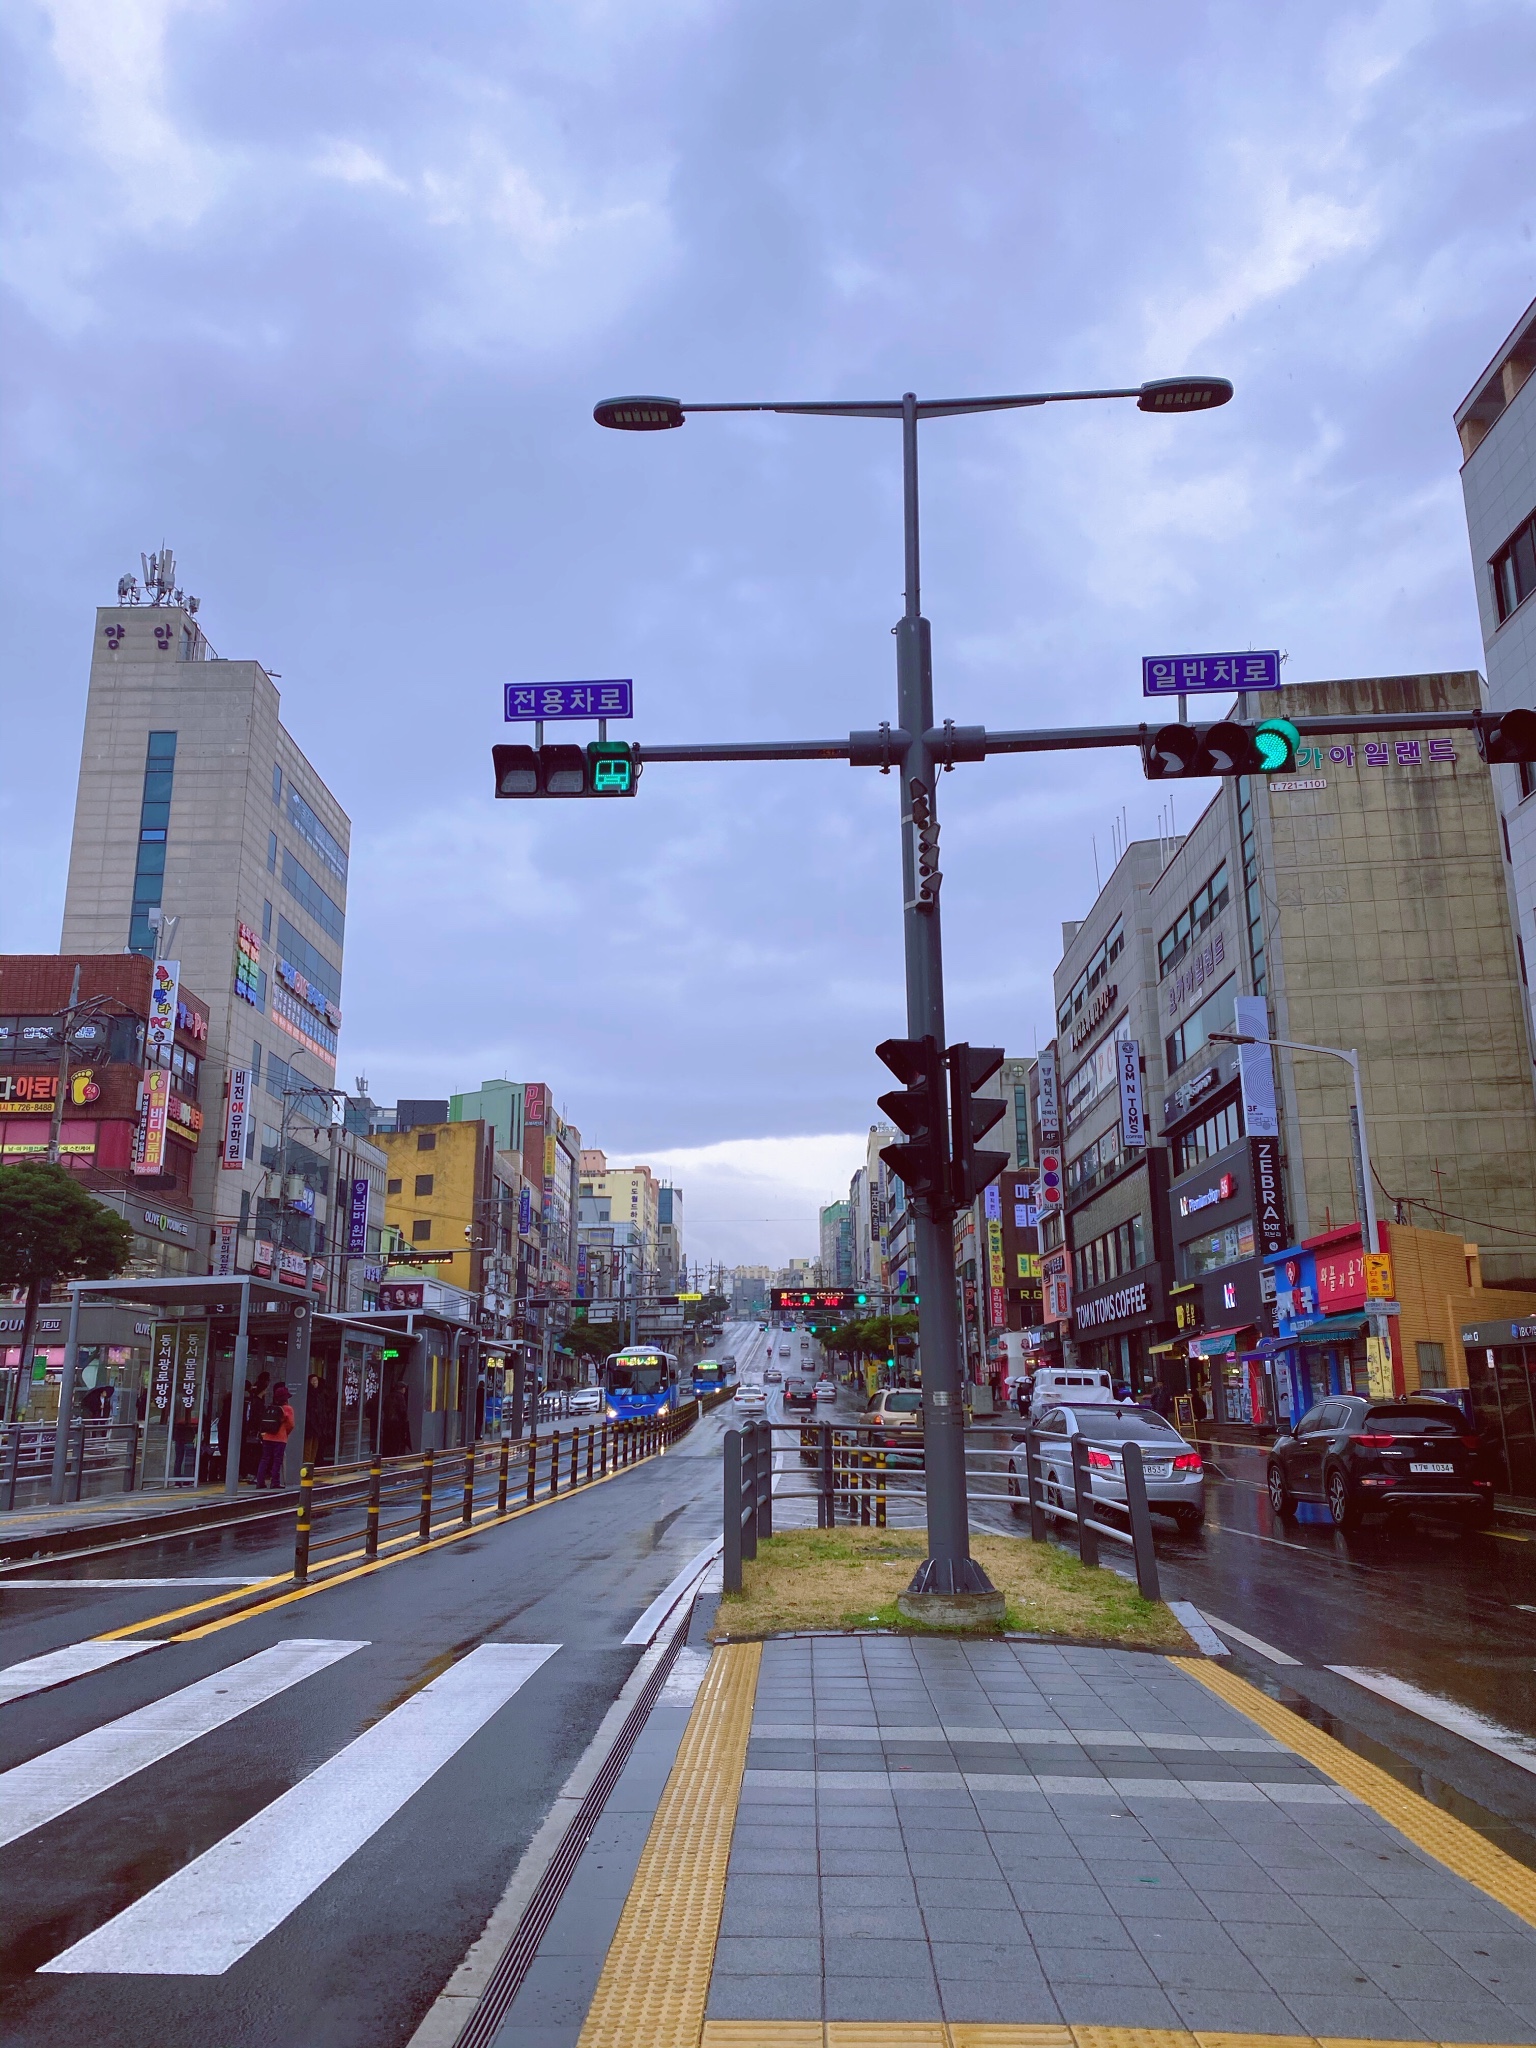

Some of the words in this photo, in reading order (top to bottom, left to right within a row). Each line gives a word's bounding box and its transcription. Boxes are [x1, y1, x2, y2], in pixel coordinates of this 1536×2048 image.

[1151, 659, 1270, 689] 일반차로
[513, 687, 623, 714] 전용차로
[1271, 780, 1326, 791] T.721-1101
[1125, 1055, 1135, 1081] TOM
[86, 1086, 96, 1094] 24
[525, 1085, 543, 1120] PC
[1127, 1085, 1135, 1094] N
[1042, 1117, 1058, 1127] PC
[1128, 1098, 1139, 1134] TOMS
[1258, 1144, 1280, 1220] ZEBRA
[352, 1195, 366, 1237] 넘버원
[1263, 1221, 1280, 1231] bar
[1095, 1294, 1116, 1323] TOMS
[1115, 1282, 1147, 1319] COFFEE
[41, 1320, 60, 1329] JEJU
[155, 1334, 172, 1409] 동서광로방향
[182, 1333, 199, 1408] 동서문로방향
[1432, 1464, 1450, 1472] 1034
